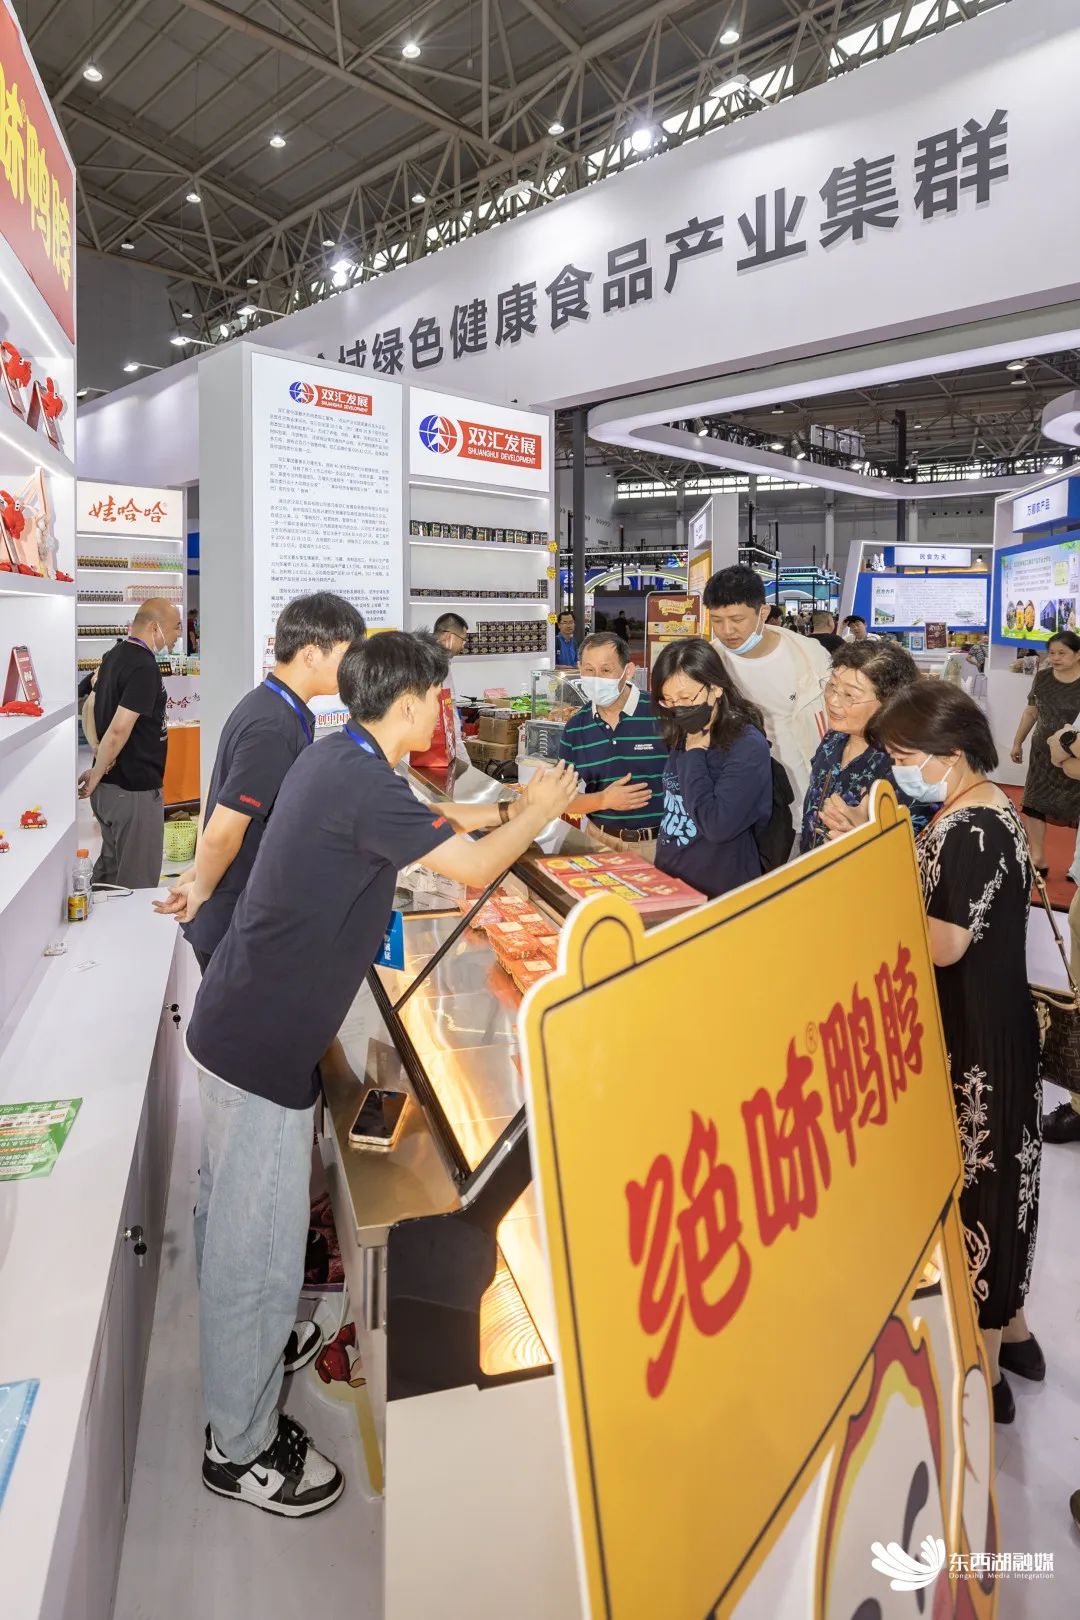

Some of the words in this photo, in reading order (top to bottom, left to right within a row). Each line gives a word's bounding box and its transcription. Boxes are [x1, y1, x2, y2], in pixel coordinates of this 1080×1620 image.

[318, 109, 1009, 376] 域绿色健康食品产业集群
[321, 388, 368, 407] 双汇发展
[467, 446, 500, 459] SHUANGHUI
[500, 453, 536, 465] DEVELOPMENT
[468, 426, 536, 456] 双汇发展
[88, 495, 168, 523] 娃哈哈
[625, 942, 925, 1399] 绝味鸭脖
